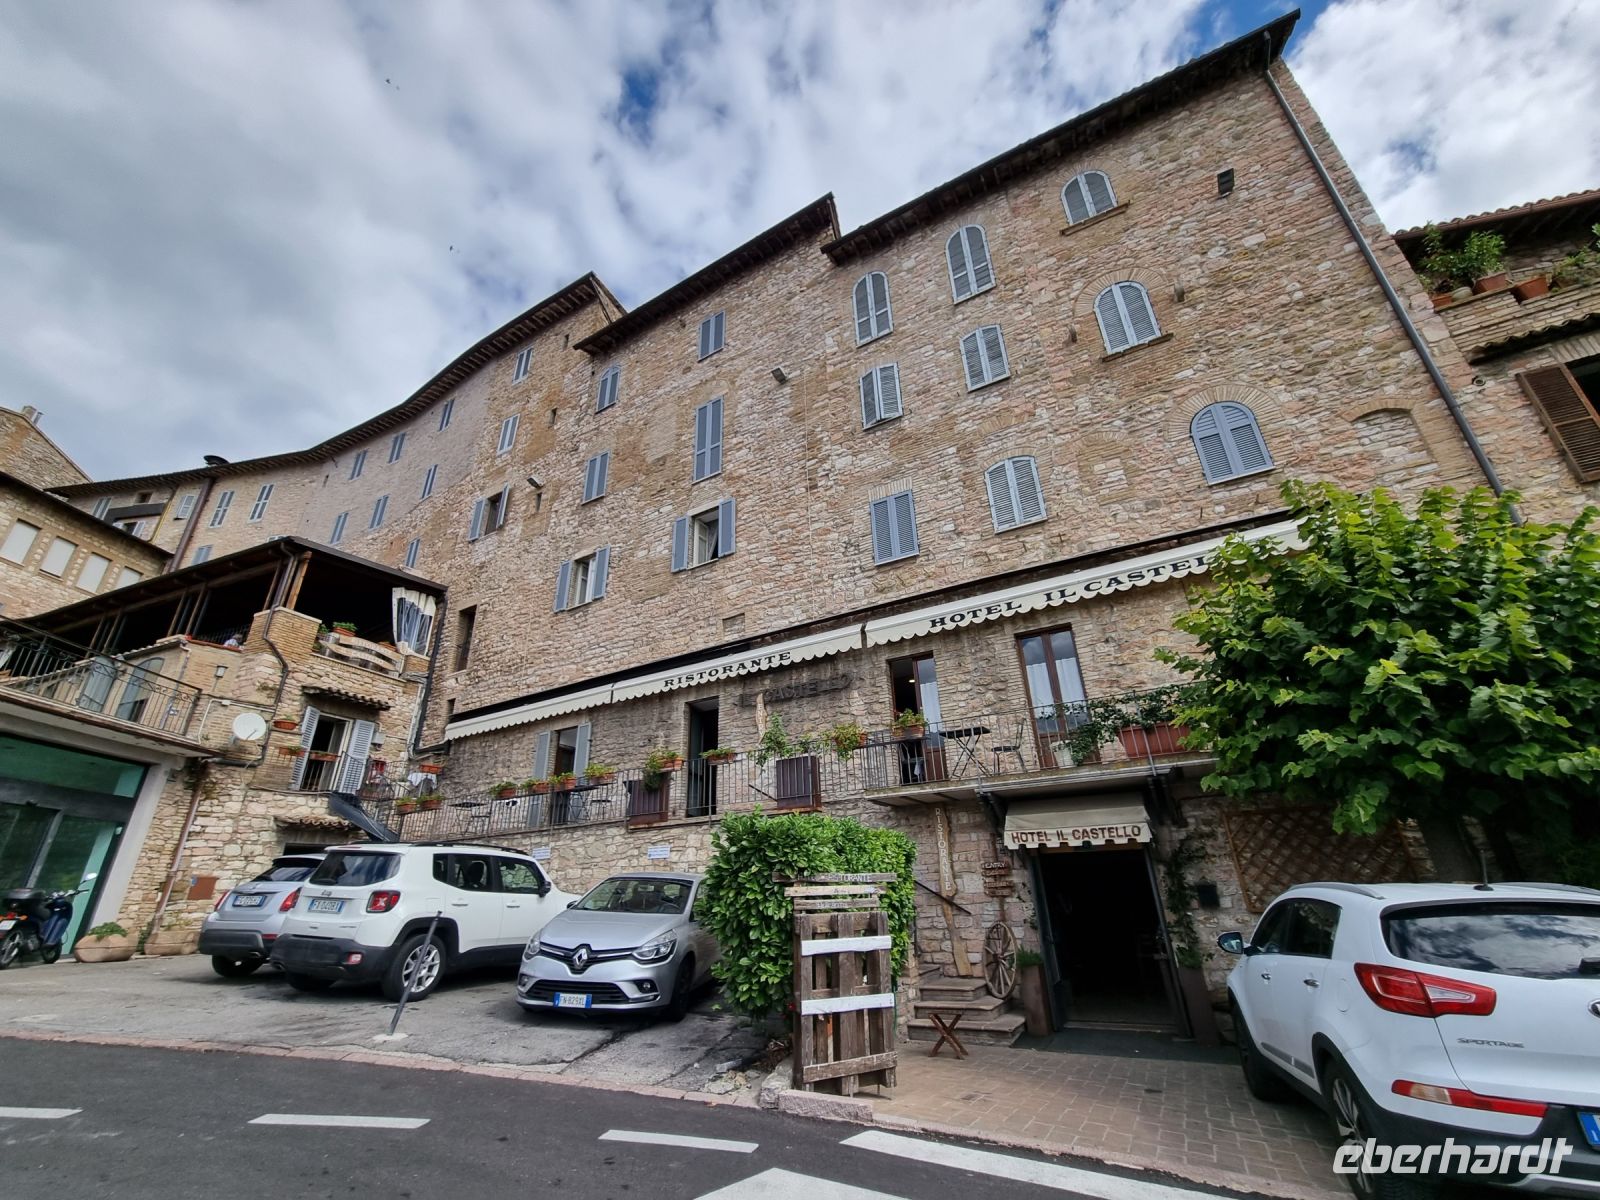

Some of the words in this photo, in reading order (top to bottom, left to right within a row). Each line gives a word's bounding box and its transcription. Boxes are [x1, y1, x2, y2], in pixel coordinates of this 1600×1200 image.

[930, 601, 1022, 629] HOTEL
[1044, 590, 1077, 602] IL
[1084, 556, 1210, 592] CASTEL
[664, 651, 792, 688] RISTORANTE
[935, 807, 953, 891] RISTORANTE
[1011, 831, 1052, 844] HOTEL
[1056, 830, 1069, 841] IL
[1072, 825, 1142, 840] CASTELLO
[1456, 1037, 1525, 1049] SPORTAGE
